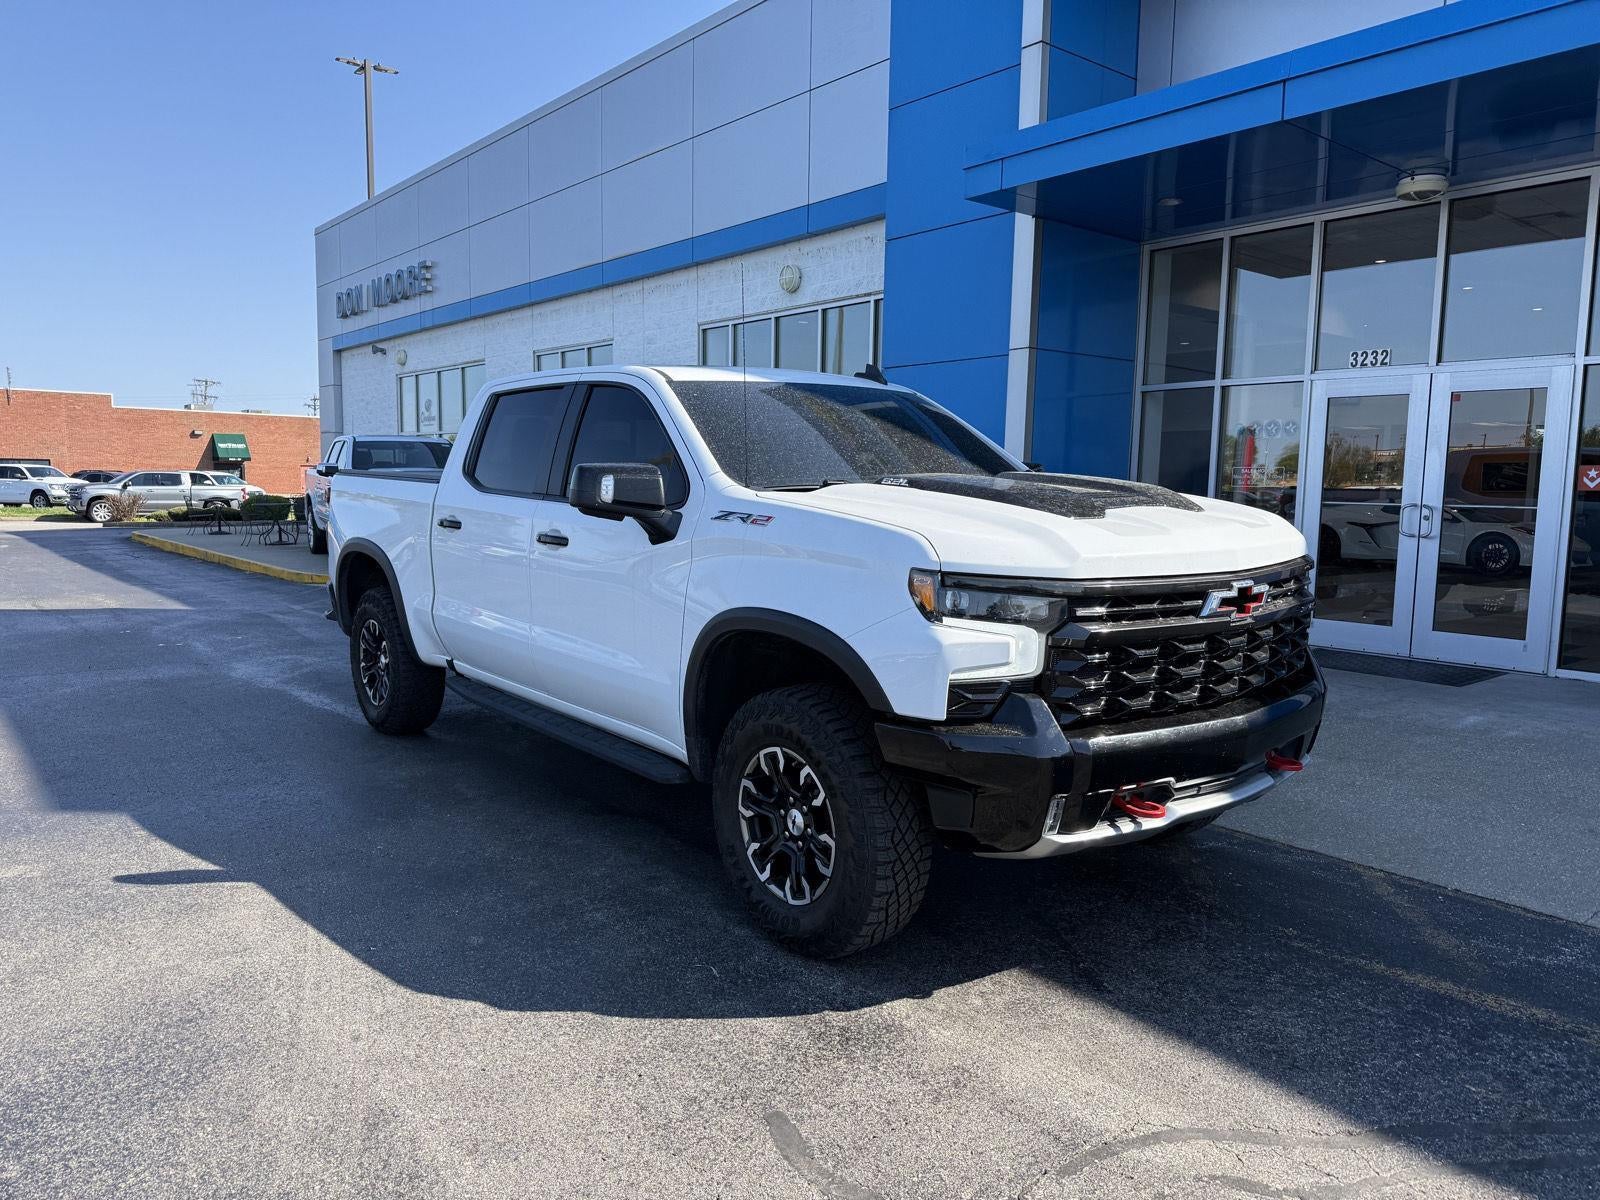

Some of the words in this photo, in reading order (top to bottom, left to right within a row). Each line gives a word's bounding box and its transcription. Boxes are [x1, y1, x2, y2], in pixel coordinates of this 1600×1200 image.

[336, 283, 367, 318] DON
[371, 260, 433, 307] MOORE
[1350, 349, 1389, 368] 3232
[710, 510, 775, 527] ZR2
